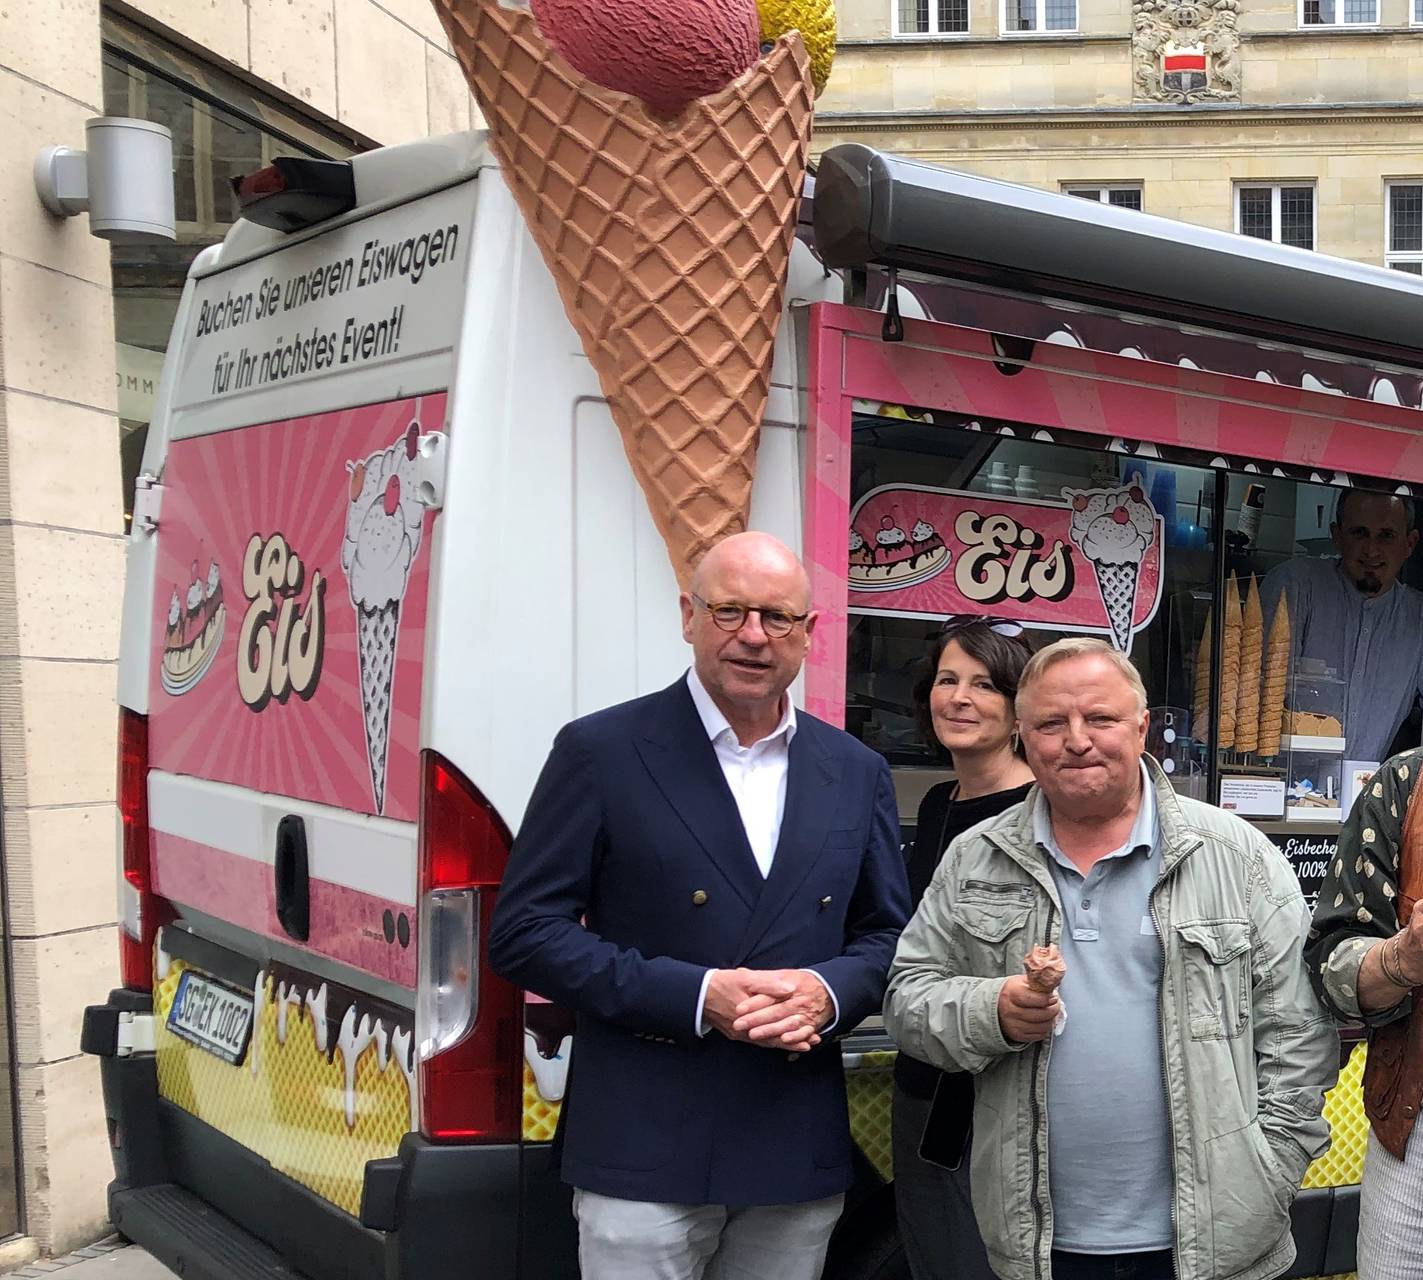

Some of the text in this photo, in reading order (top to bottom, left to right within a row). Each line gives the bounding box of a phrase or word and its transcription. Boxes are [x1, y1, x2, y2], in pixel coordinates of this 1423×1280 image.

[196, 223, 460, 337] Buchen Sie unseren Eiswagen
[211, 304, 405, 394] für Ihr nächstes Event!
[954, 510, 1074, 604] Eis
[236, 532, 327, 713] Eis
[1285, 838, 1337, 858] Eisbeche
[1297, 861, 1328, 878] 100%
[212, 999, 249, 1047] 1002
